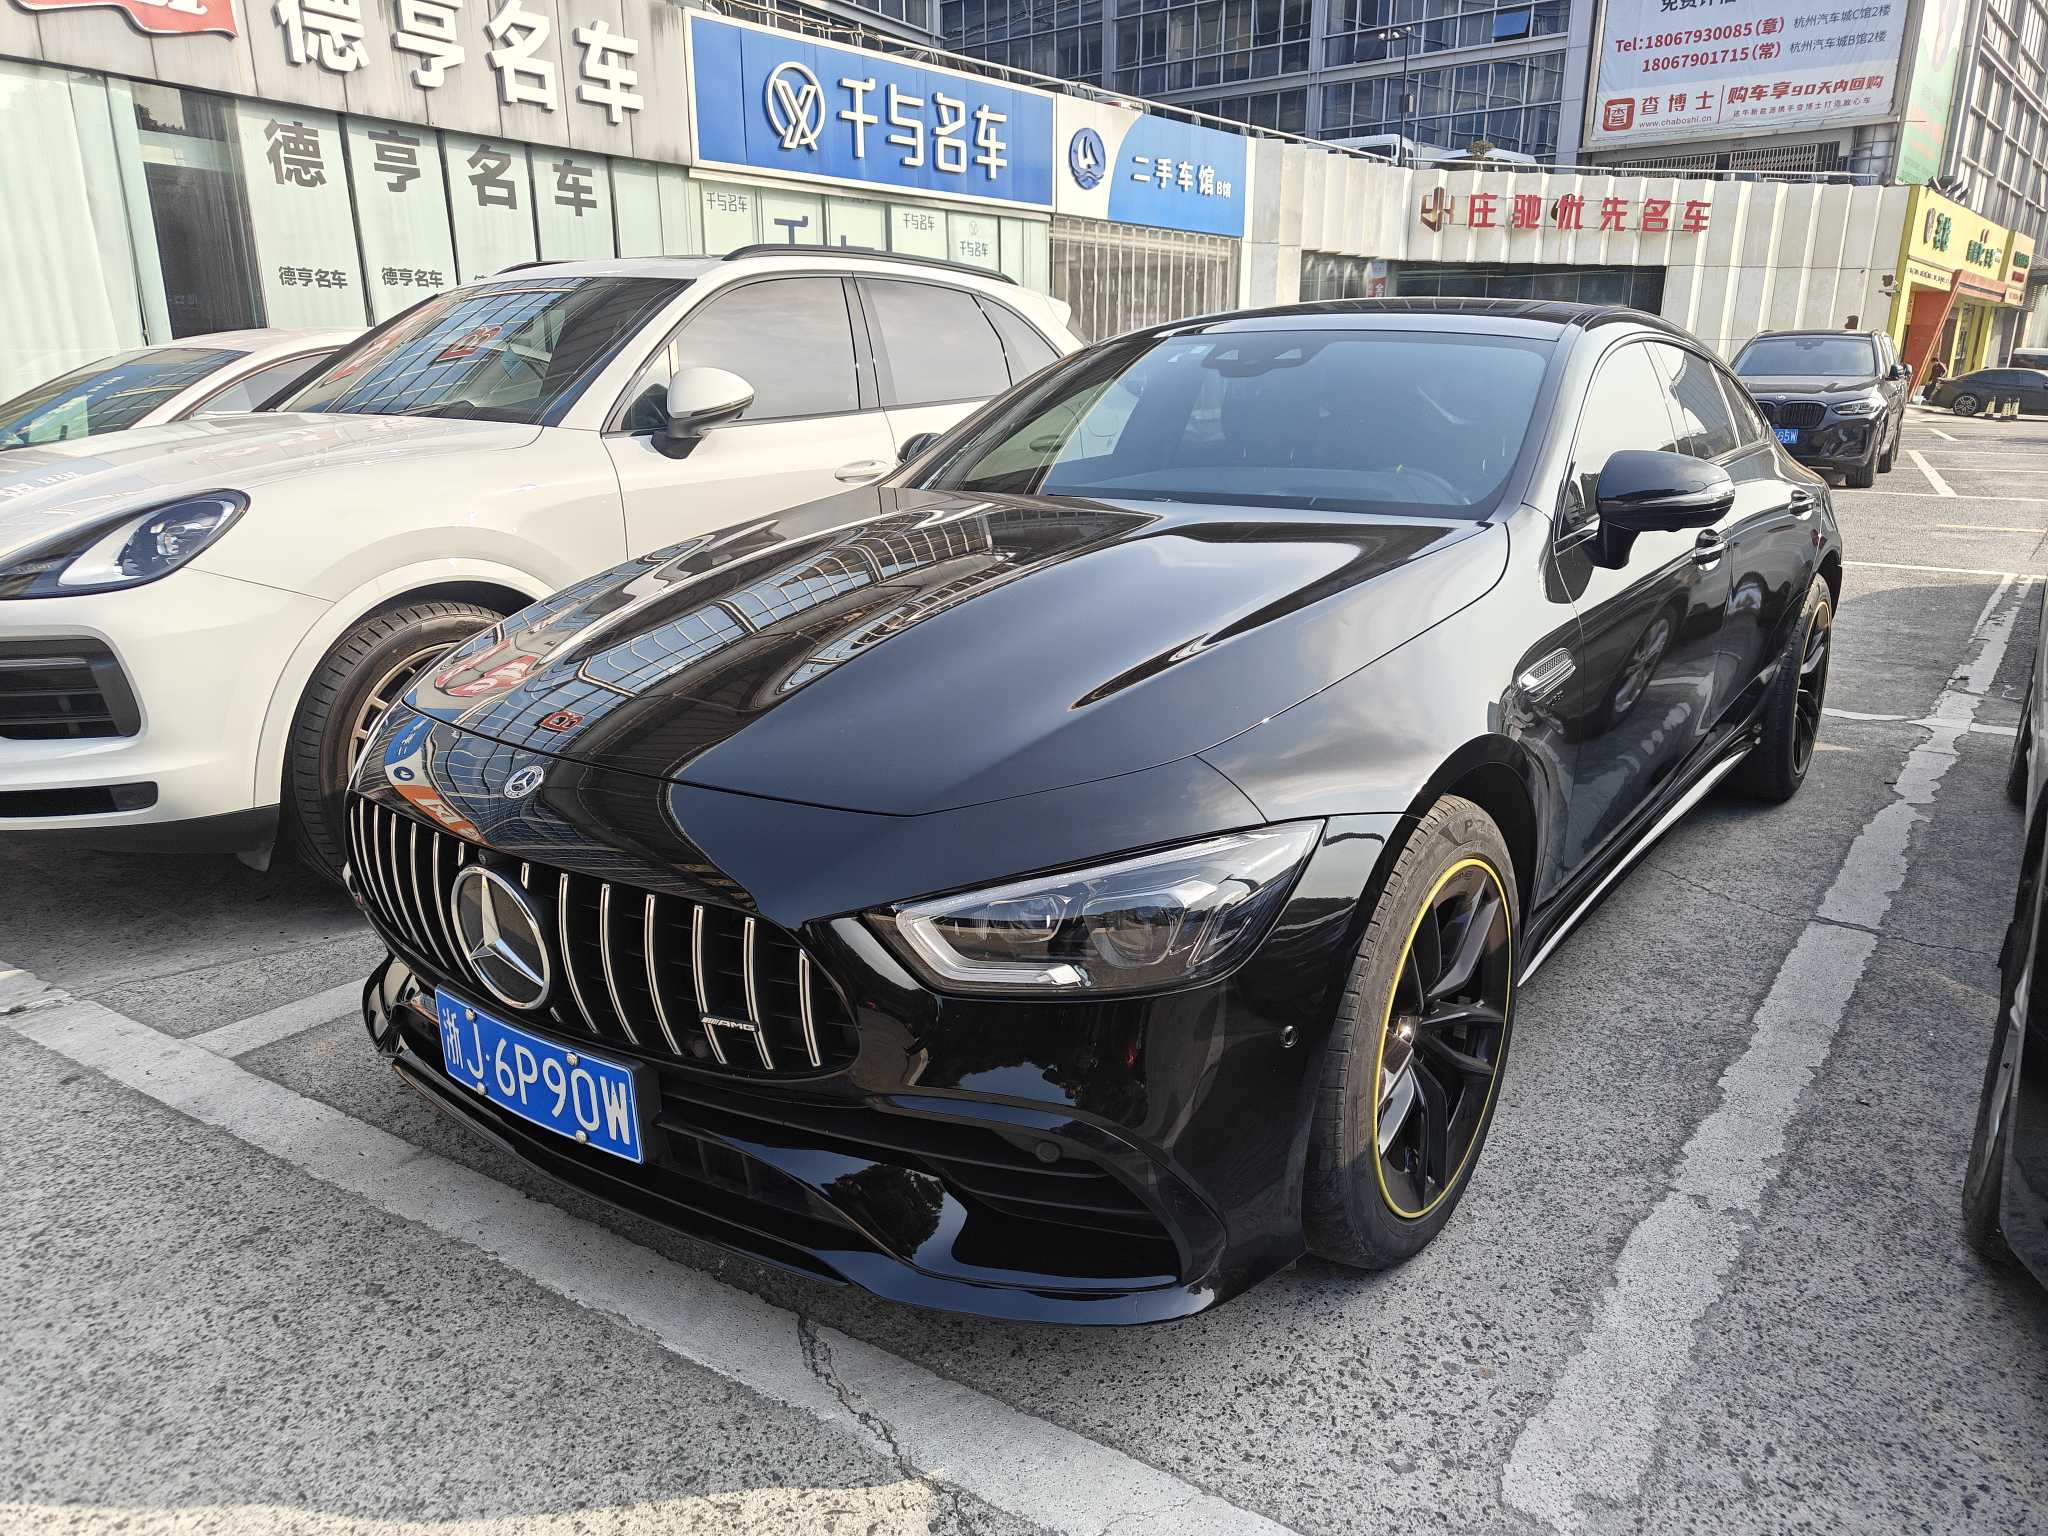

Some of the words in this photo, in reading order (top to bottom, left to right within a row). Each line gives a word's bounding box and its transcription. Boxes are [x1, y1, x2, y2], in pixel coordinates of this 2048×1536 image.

[272, 0, 644, 124] 德亨名车
[1641, 91, 1715, 116] 查博士
[1727, 76, 1884, 105] 购车享90天内回购
[839, 77, 1008, 180] 千与名车
[263, 118, 598, 217] 德亨名车
[706, 191, 748, 213] 千与名车
[1468, 192, 1712, 233] 庄驰优先名车
[903, 212, 936, 231] 千与名车
[278, 265, 348, 289] 德亨名车
[381, 266, 444, 289] 德亨名车
